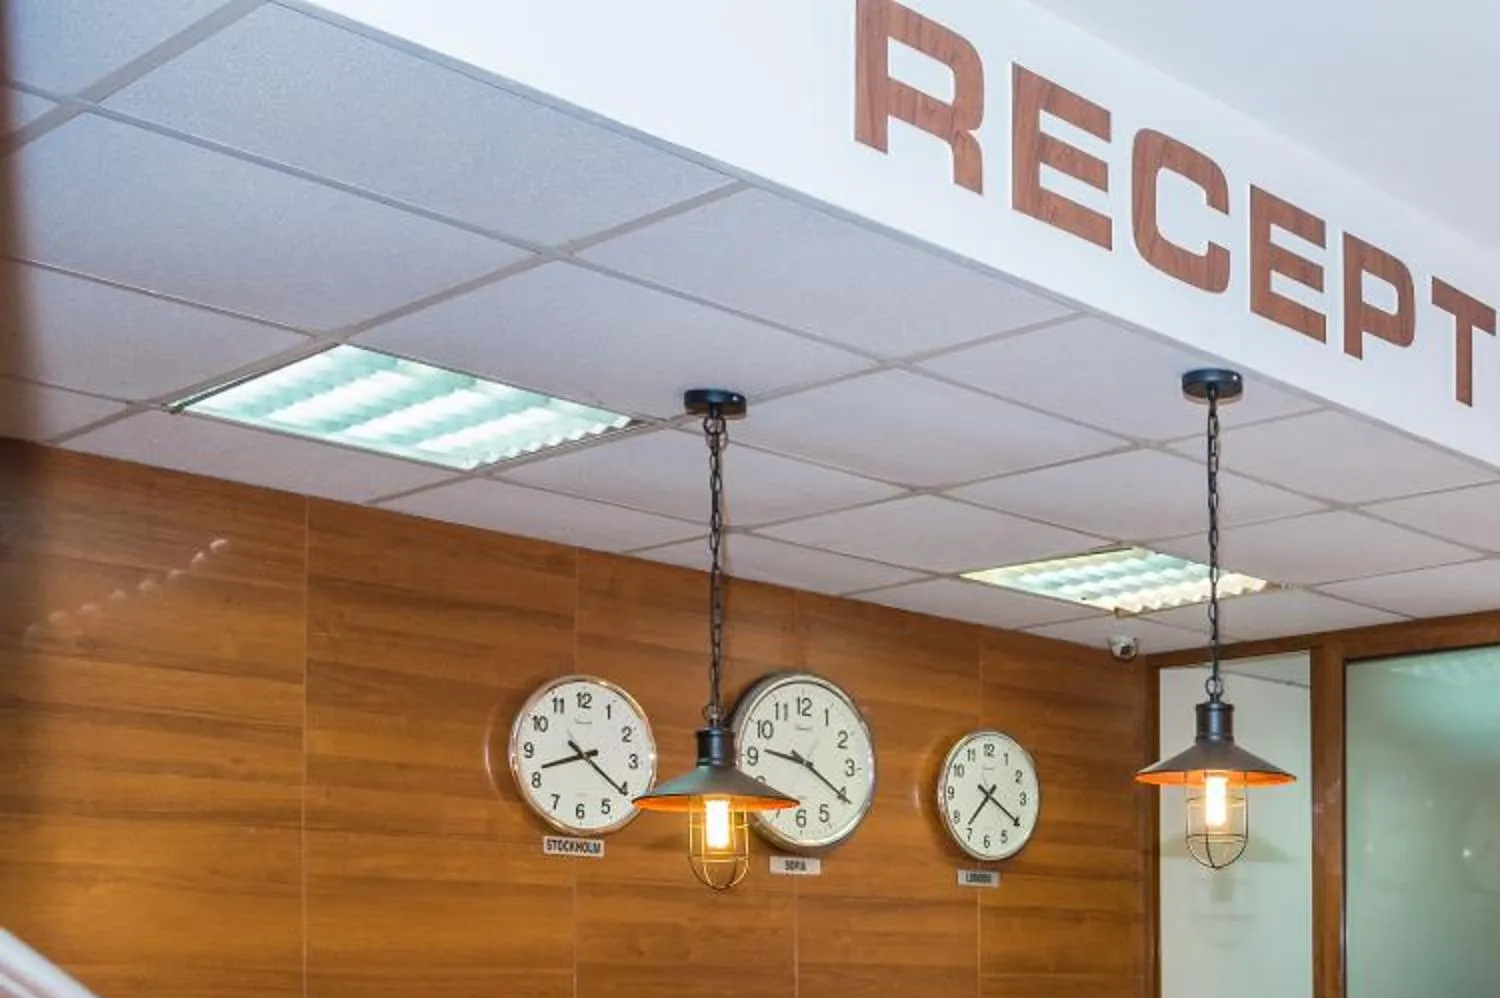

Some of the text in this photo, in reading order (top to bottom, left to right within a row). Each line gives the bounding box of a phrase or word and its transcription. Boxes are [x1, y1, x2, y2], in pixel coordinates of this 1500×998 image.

[552, 697, 565, 714] 11
[576, 692, 593, 709] 12
[796, 696, 813, 717] 12
[774, 702, 788, 722] 11
[532, 715, 549, 733] 10
[756, 719, 774, 739] 10
[621, 726, 632, 743] 2
[837, 730, 848, 749] 2
[523, 742, 535, 759] 9
[747, 747, 759, 766] 9
[967, 748, 976, 762] 11
[983, 743, 995, 757] 12
[628, 753, 639, 770] 3
[845, 759, 855, 777] 3
[953, 763, 965, 778] 10
[1015, 770, 1023, 783] 2
[531, 772, 542, 788] 8
[947, 786, 955, 800] 9
[1019, 791, 1027, 806] 3
[551, 794, 560, 810] 7
[601, 799, 611, 814] 5
[575, 803, 585, 819] 6
[795, 809, 806, 828] 6
[819, 804, 829, 823] 5
[953, 810, 961, 824] 8
[965, 828, 973, 841] 7
[983, 835, 991, 848] 6
[1000, 830, 1008, 843] 5
[546, 838, 601, 854] STOCKHOLM
